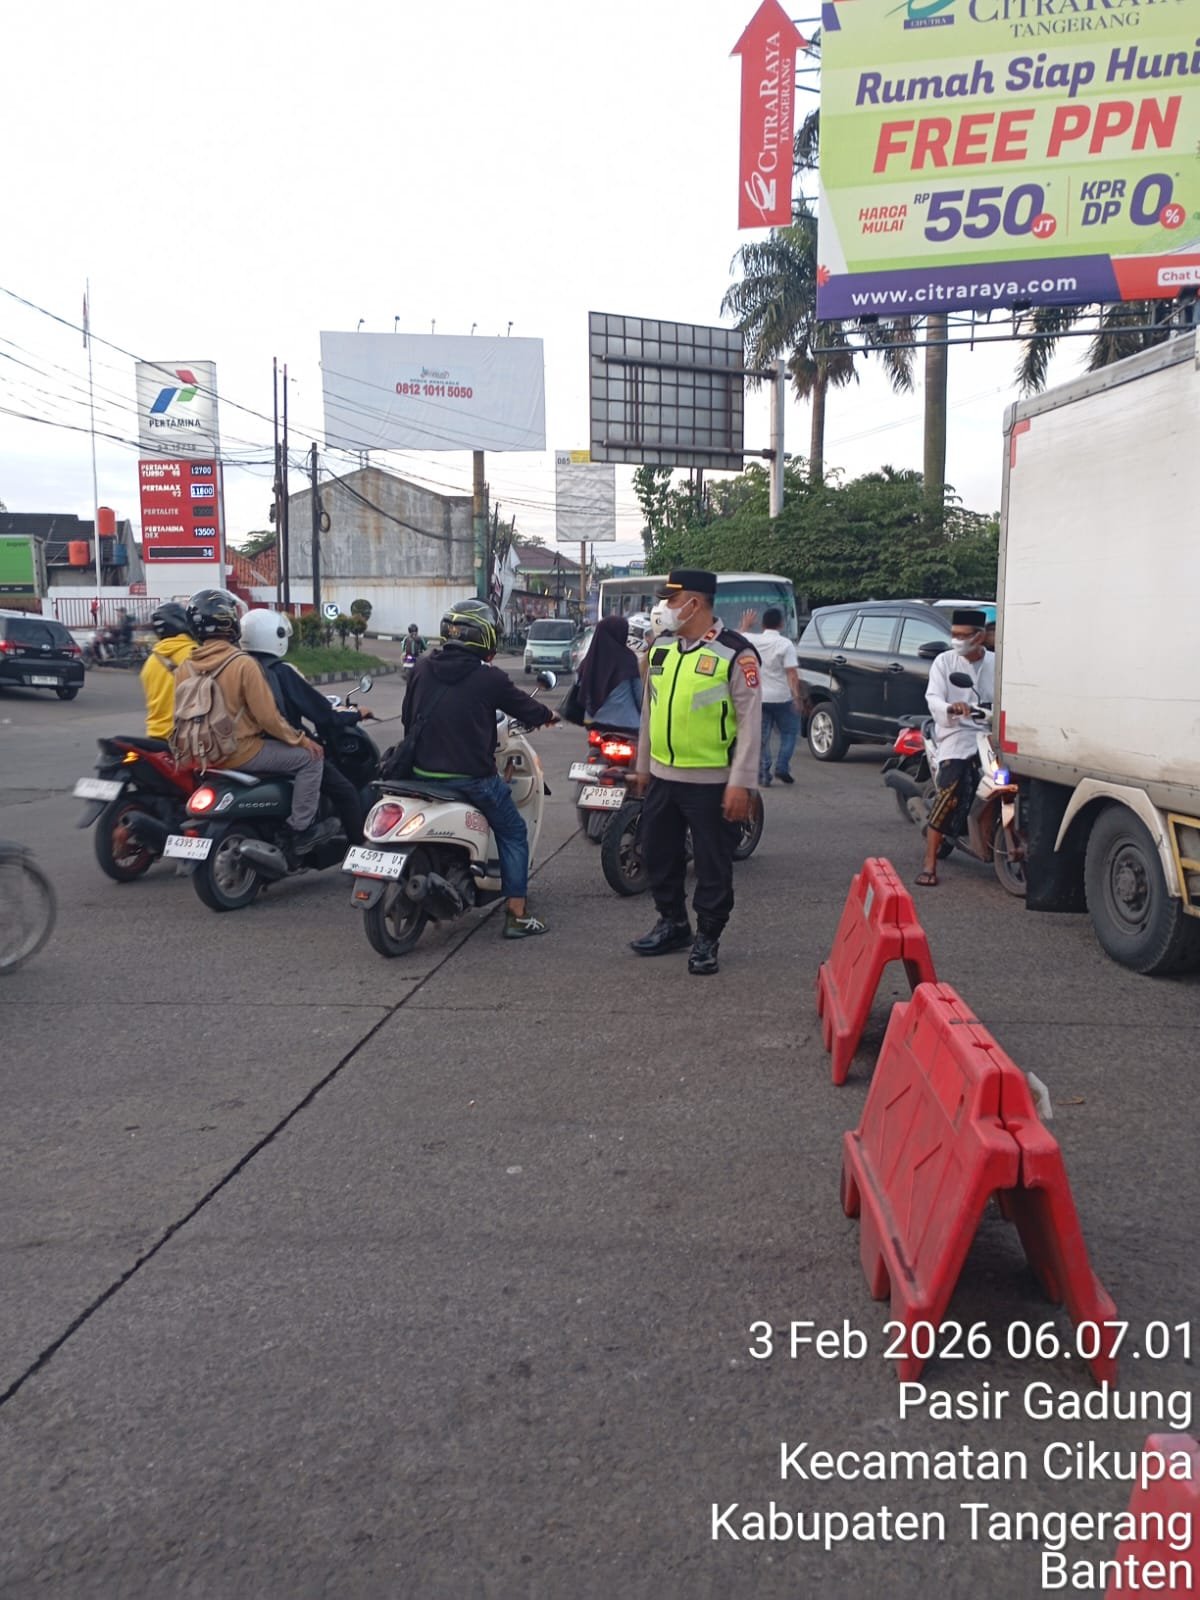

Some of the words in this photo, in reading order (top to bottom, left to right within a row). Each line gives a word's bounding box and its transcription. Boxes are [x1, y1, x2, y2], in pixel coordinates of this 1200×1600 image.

[1010, 12, 1140, 38] TANGERANG
[856, 60, 994, 105] Rumah
[1005, 53, 1095, 97] Siap
[1106, 37, 1200, 82] Huni
[780, 58, 791, 143] TANGERANG
[873, 108, 1035, 173] FREE
[1046, 96, 1182, 158] PPN
[1080, 179, 1126, 201] KPR
[859, 205, 907, 221] HARGA
[1081, 201, 1122, 226] DP
[862, 220, 904, 234] MULAI
[1034, 219, 1054, 233] JT
[1162, 271, 1190, 281] Chat
[852, 274, 1077, 306] www.citraraya.com
[396, 382, 420, 395] 0812
[423, 384, 445, 397] 1011
[447, 386, 473, 399] 5050
[149, 419, 200, 428] PERTAMINA
[141, 463, 180, 471] PERTAMAX
[142, 484, 181, 492] PERTAMAX
[144, 525, 184, 533] PERTAMINA
